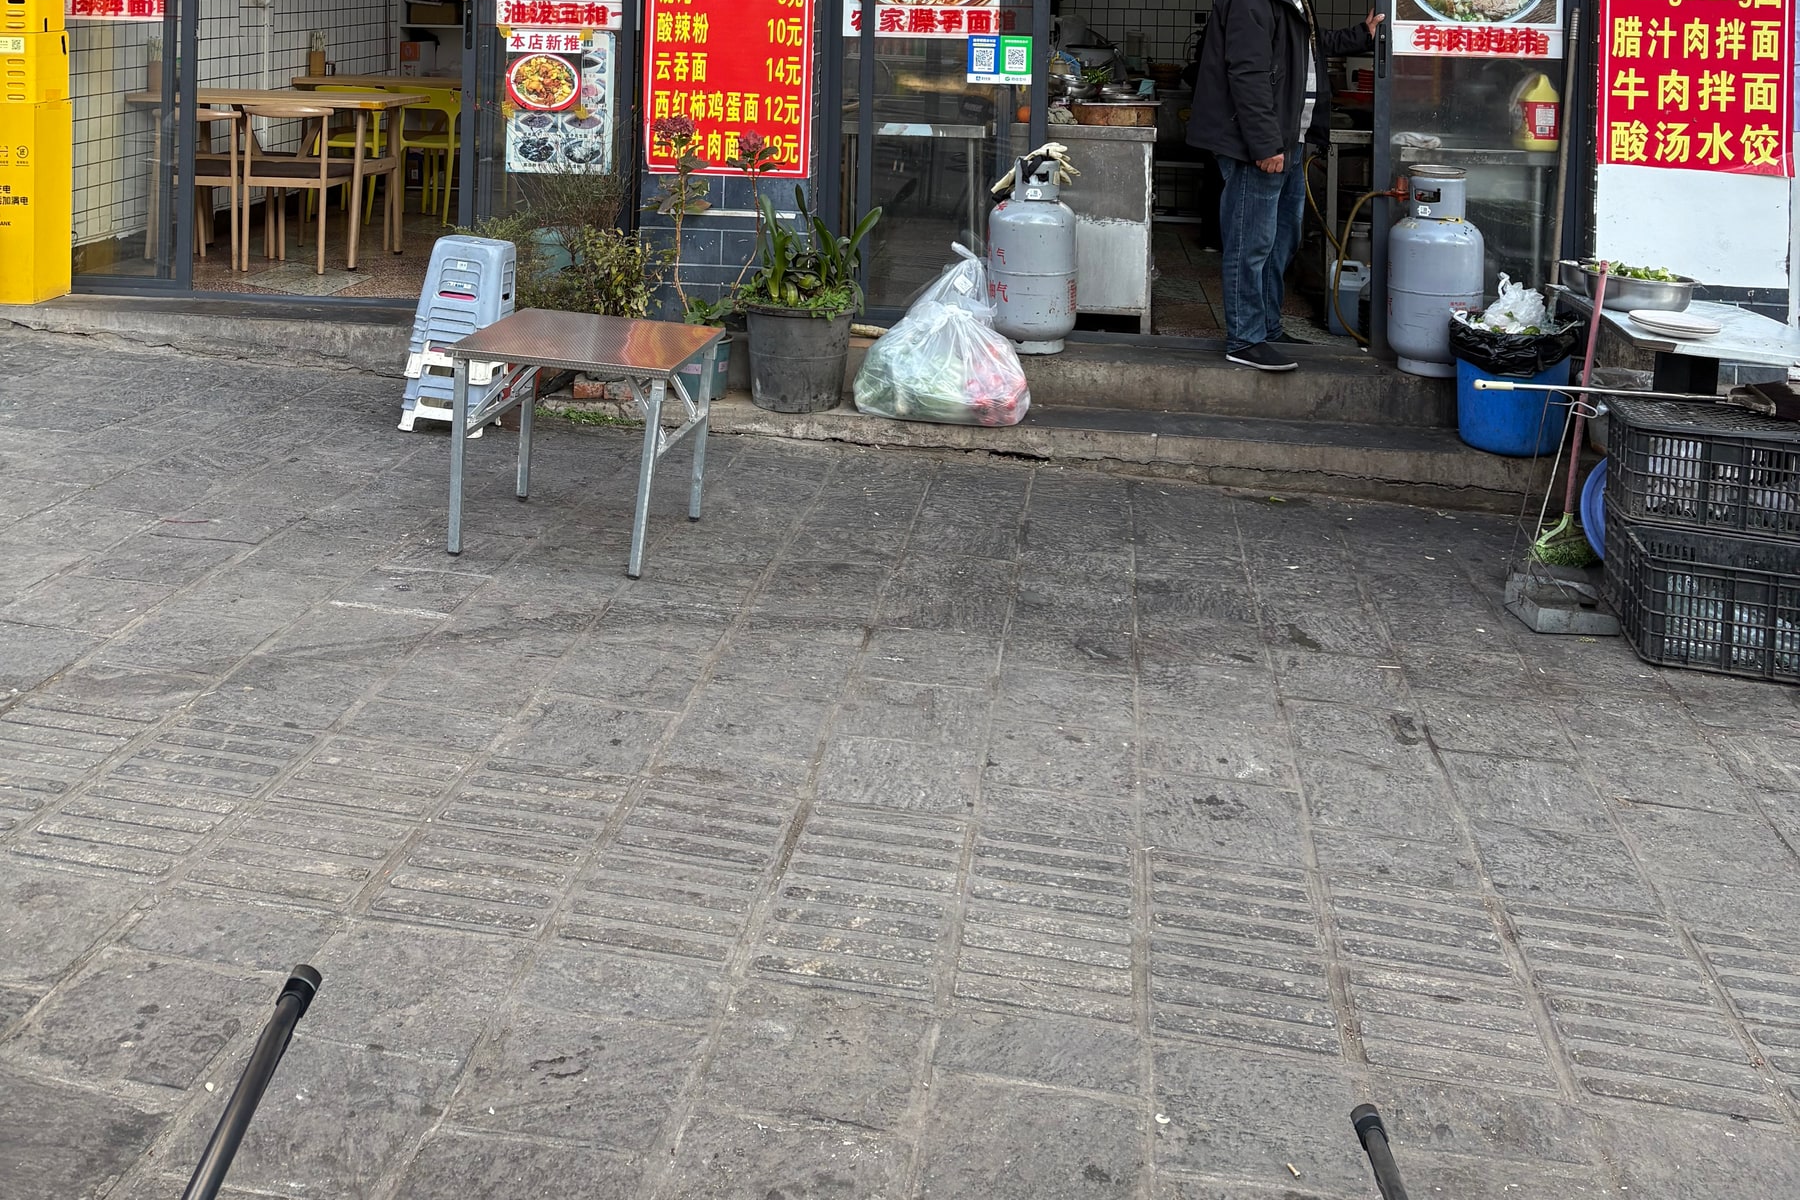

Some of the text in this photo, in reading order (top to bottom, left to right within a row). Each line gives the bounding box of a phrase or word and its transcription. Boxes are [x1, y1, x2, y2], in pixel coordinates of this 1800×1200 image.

[510, 33, 580, 51] 本店新推
[657, 12, 803, 47] 酸辣粉 10元
[1612, 17, 1781, 61] 腊汁肉拌面
[656, 52, 801, 86] 云吞面 14元
[654, 90, 800, 125] 西红柿鸡蛋面 12元
[1611, 69, 1780, 113] 牛肉拌面
[1610, 121, 1779, 166] 酸汤水饺
[0, 196, 29, 206] 加满电
